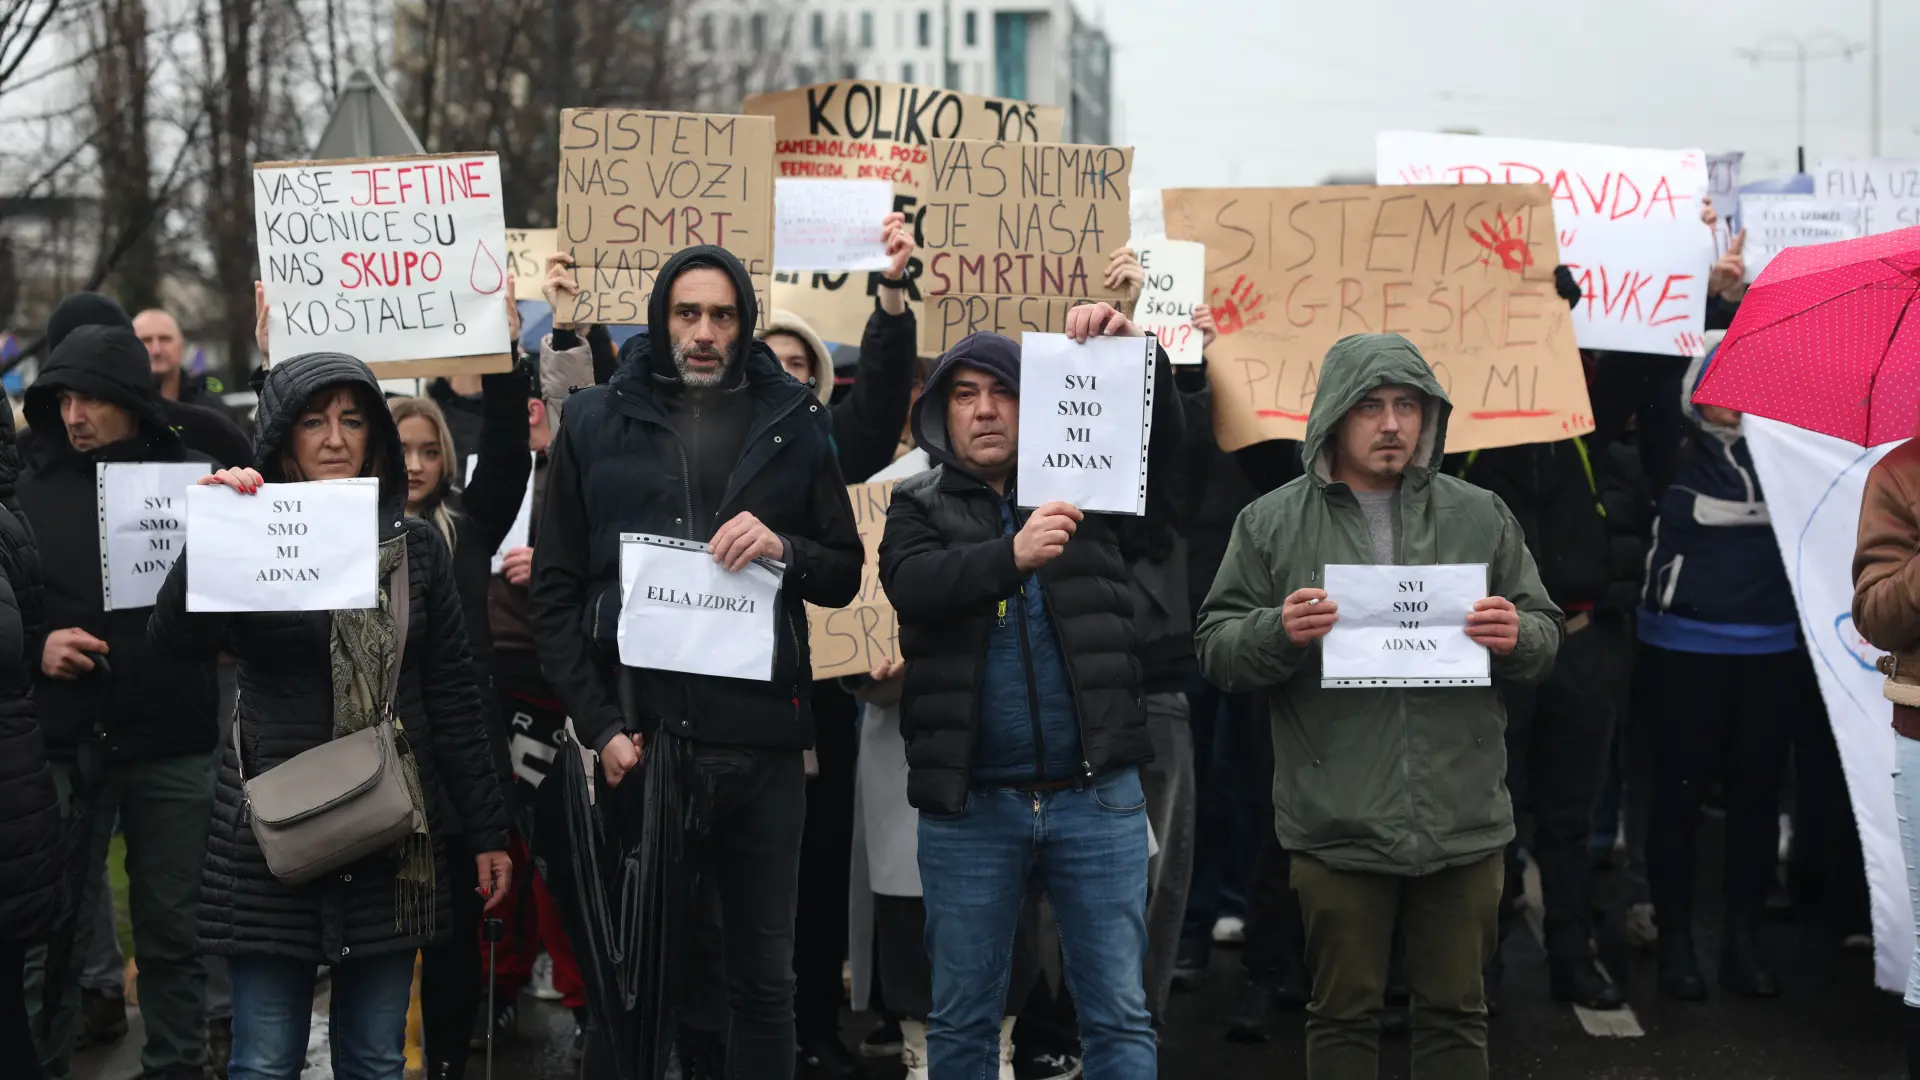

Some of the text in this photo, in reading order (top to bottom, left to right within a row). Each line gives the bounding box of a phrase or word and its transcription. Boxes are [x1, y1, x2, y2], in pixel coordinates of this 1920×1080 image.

[807, 83, 963, 145] KOLIKO
[564, 111, 737, 156] SISTEM
[930, 139, 1125, 201] VAŠ NEMAR
[258, 161, 490, 206] VAŠE JEFTINE
[564, 158, 748, 201] NAS VOZI
[264, 207, 456, 246] KOČNICE SU
[566, 203, 592, 243] U
[926, 203, 970, 249] JE
[998, 200, 1105, 256] NAŠA
[269, 251, 442, 289] NAS SKUPO
[929, 252, 1088, 297] SMRTNA
[1285, 274, 1546, 347] GREŠKE
[1064, 374, 1098, 391] SVI
[1481, 363, 1539, 412] MI
[1057, 400, 1102, 417] SMO
[1065, 427, 1092, 442] MI
[1042, 453, 1113, 469] ADNAN
[144, 497, 172, 510] SVI
[272, 500, 302, 513] SVI
[139, 518, 179, 531] SMO
[267, 522, 308, 536] SMO
[150, 538, 171, 551] MI
[275, 545, 299, 559] MI
[255, 567, 320, 582] ADNAN
[1398, 580, 1424, 593] SVI
[646, 585, 757, 613] ELLA IZDRŽI
[1392, 601, 1429, 613] SMO
[1399, 620, 1420, 630] MI
[1381, 638, 1438, 651] ADNAN
